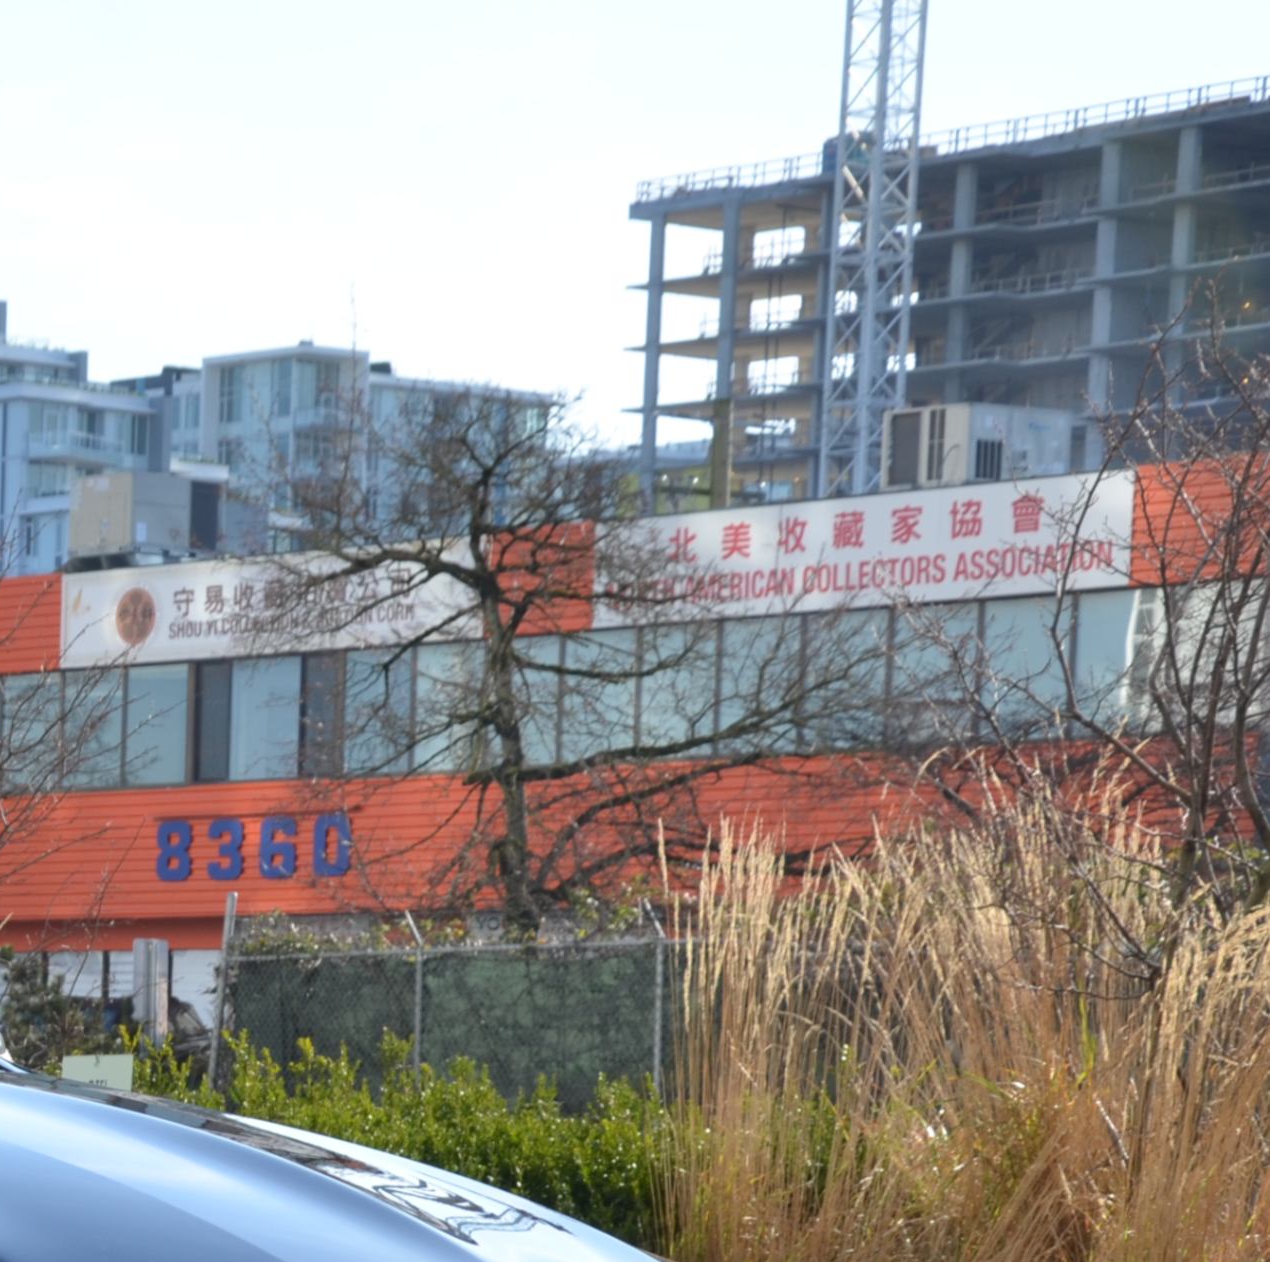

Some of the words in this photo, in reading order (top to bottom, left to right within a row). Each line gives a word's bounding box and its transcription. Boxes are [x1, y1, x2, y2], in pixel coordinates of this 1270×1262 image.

[668, 491, 1045, 563] 北美收藏家協會
[686, 566, 795, 604] AMERICAN
[802, 553, 946, 594] COLLECTORS
[953, 538, 1115, 582] ASSOCIATION
[168, 621, 202, 639] SHOU
[156, 814, 353, 882] 8360
